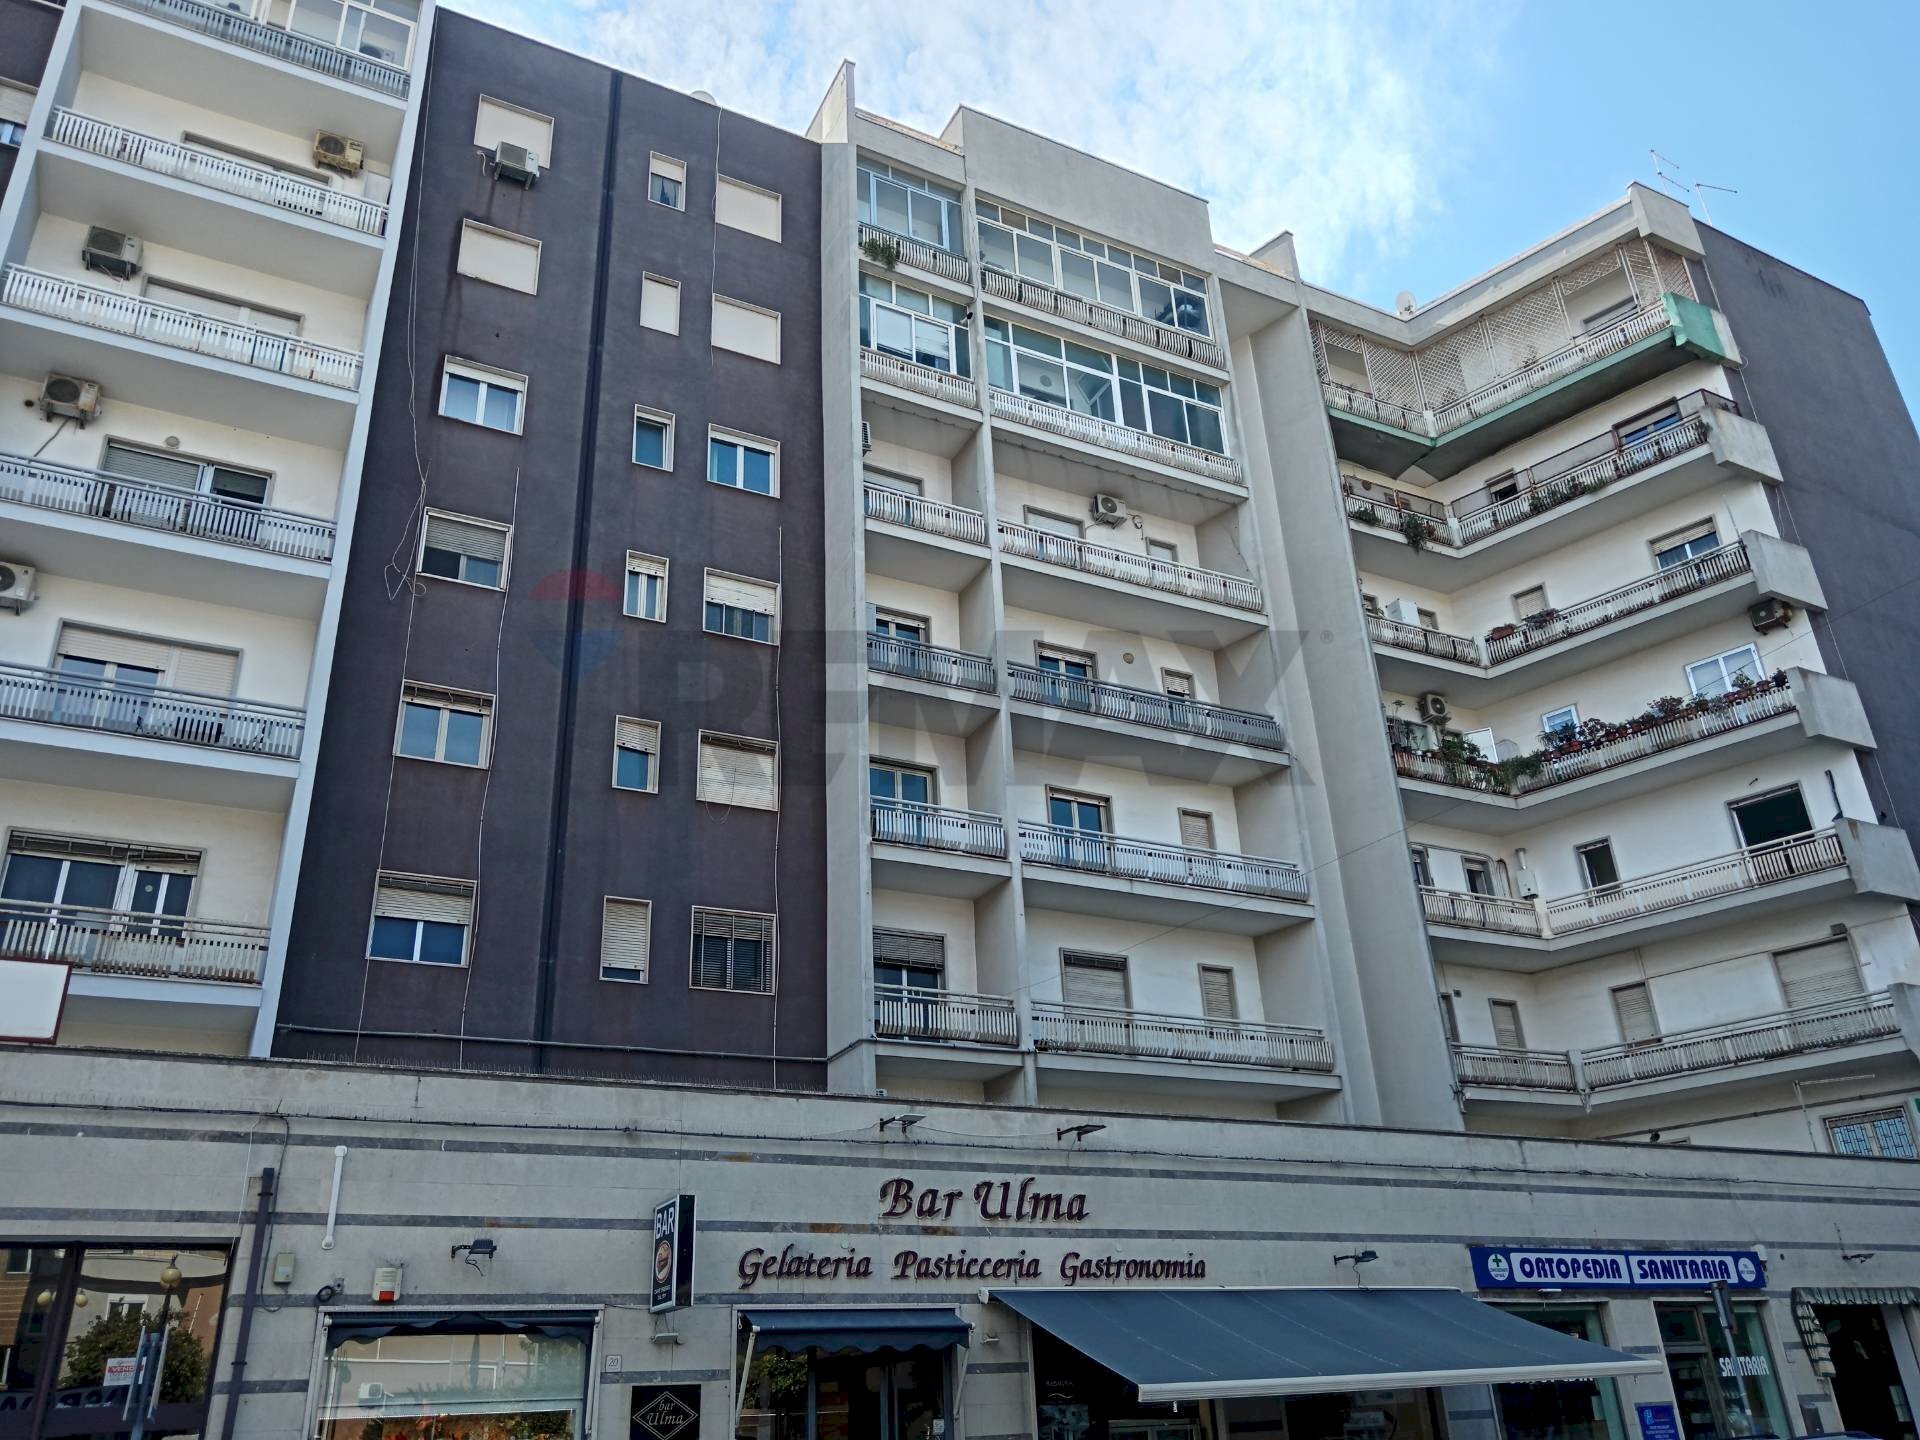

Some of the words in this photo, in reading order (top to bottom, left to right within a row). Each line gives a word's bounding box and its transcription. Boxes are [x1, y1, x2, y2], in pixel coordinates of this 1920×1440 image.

[878, 1176, 963, 1219] Bar
[974, 1176, 1089, 1223] Ulma
[656, 1206, 675, 1239] BAR
[737, 1243, 873, 1289] Gelateria
[891, 1248, 1042, 1281] Pasticceria
[1060, 1251, 1207, 1286] Gastronomia
[1519, 1257, 1622, 1279] ORTOPEDIA
[1637, 1259, 1731, 1280] SANITARIA
[646, 1410, 684, 1426] Ulma
[658, 1399, 676, 1411] bar
